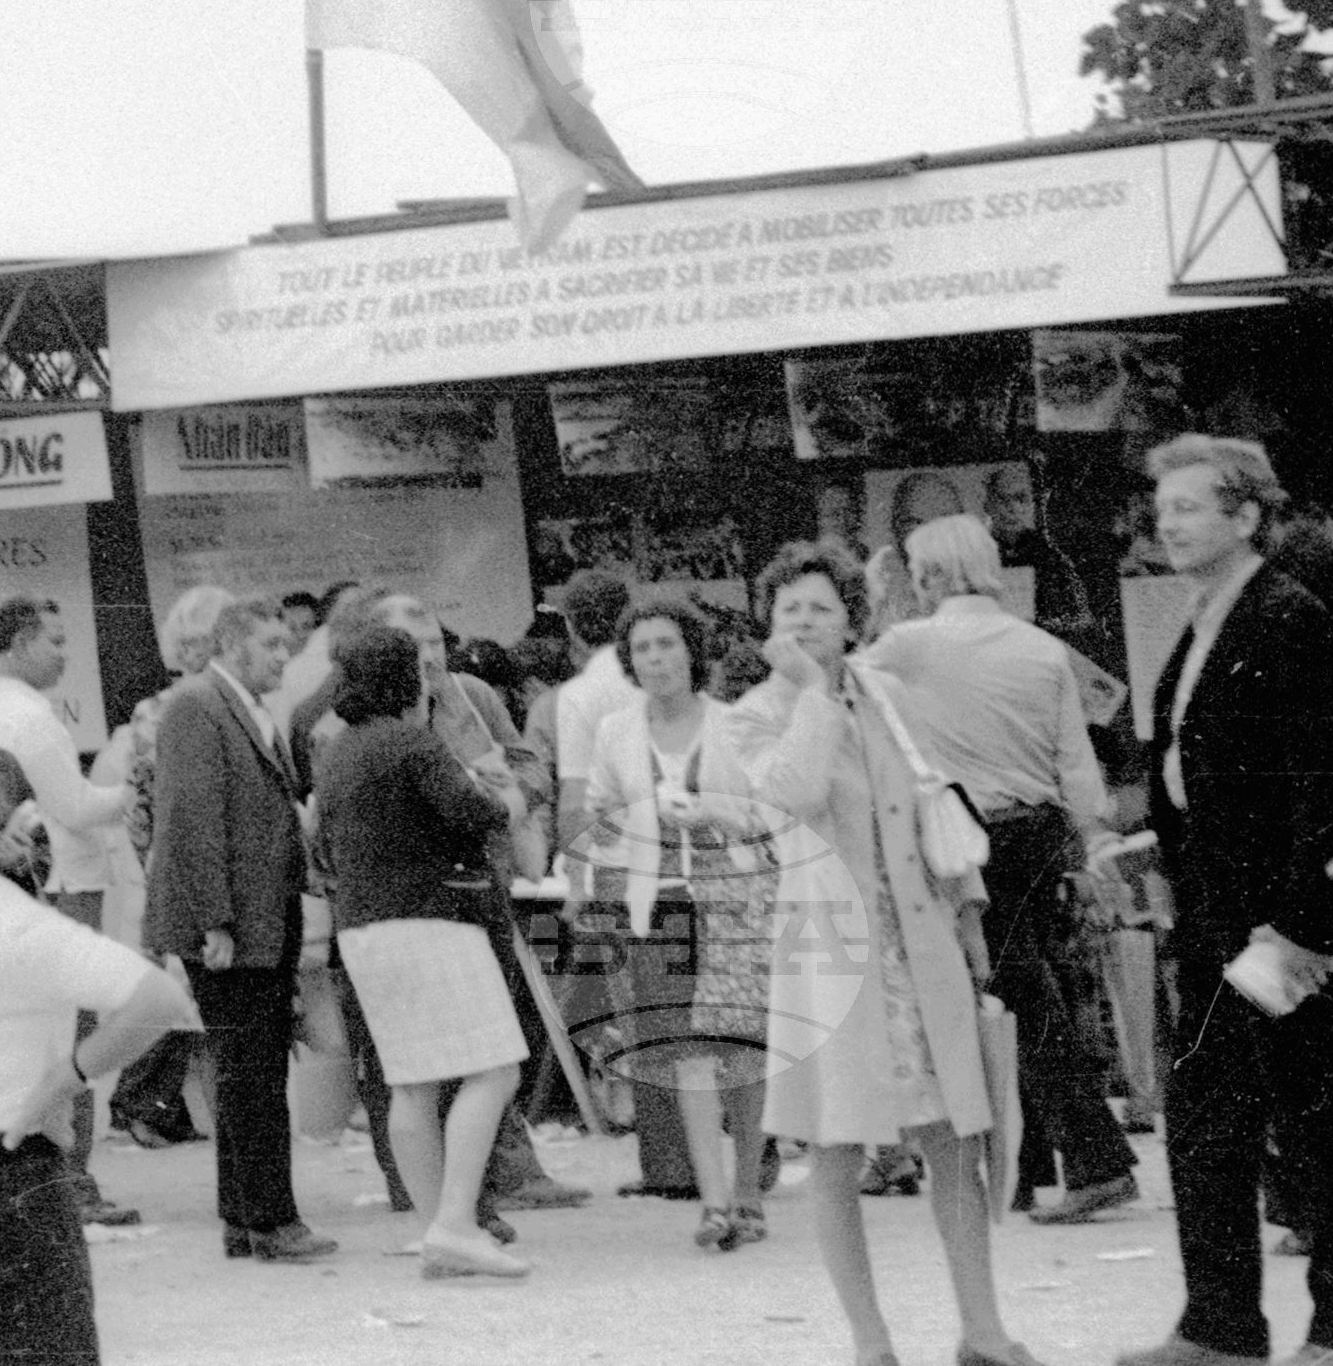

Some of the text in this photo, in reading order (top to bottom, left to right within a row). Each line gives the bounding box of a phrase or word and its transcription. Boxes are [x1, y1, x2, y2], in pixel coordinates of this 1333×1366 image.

[278, 266, 335, 294] TOUT
[341, 262, 366, 288] LE
[375, 254, 453, 283] PEUPLE
[457, 250, 491, 276] DU
[603, 234, 649, 260] EST
[757, 207, 882, 244] MOBILISER
[890, 195, 973, 229] TOUTES
[983, 190, 1028, 220] SES
[1032, 181, 1127, 215] FORCES
[354, 297, 381, 322] ET
[674, 264, 702, 288] SA
[744, 255, 773, 281] ET
[777, 249, 821, 278] SES
[827, 242, 894, 274] BIENS
[370, 326, 427, 355] POUR
[531, 310, 579, 339] SON
[581, 304, 649, 334] DROIT
[676, 298, 704, 325] LA
[805, 285, 833, 313] ET
